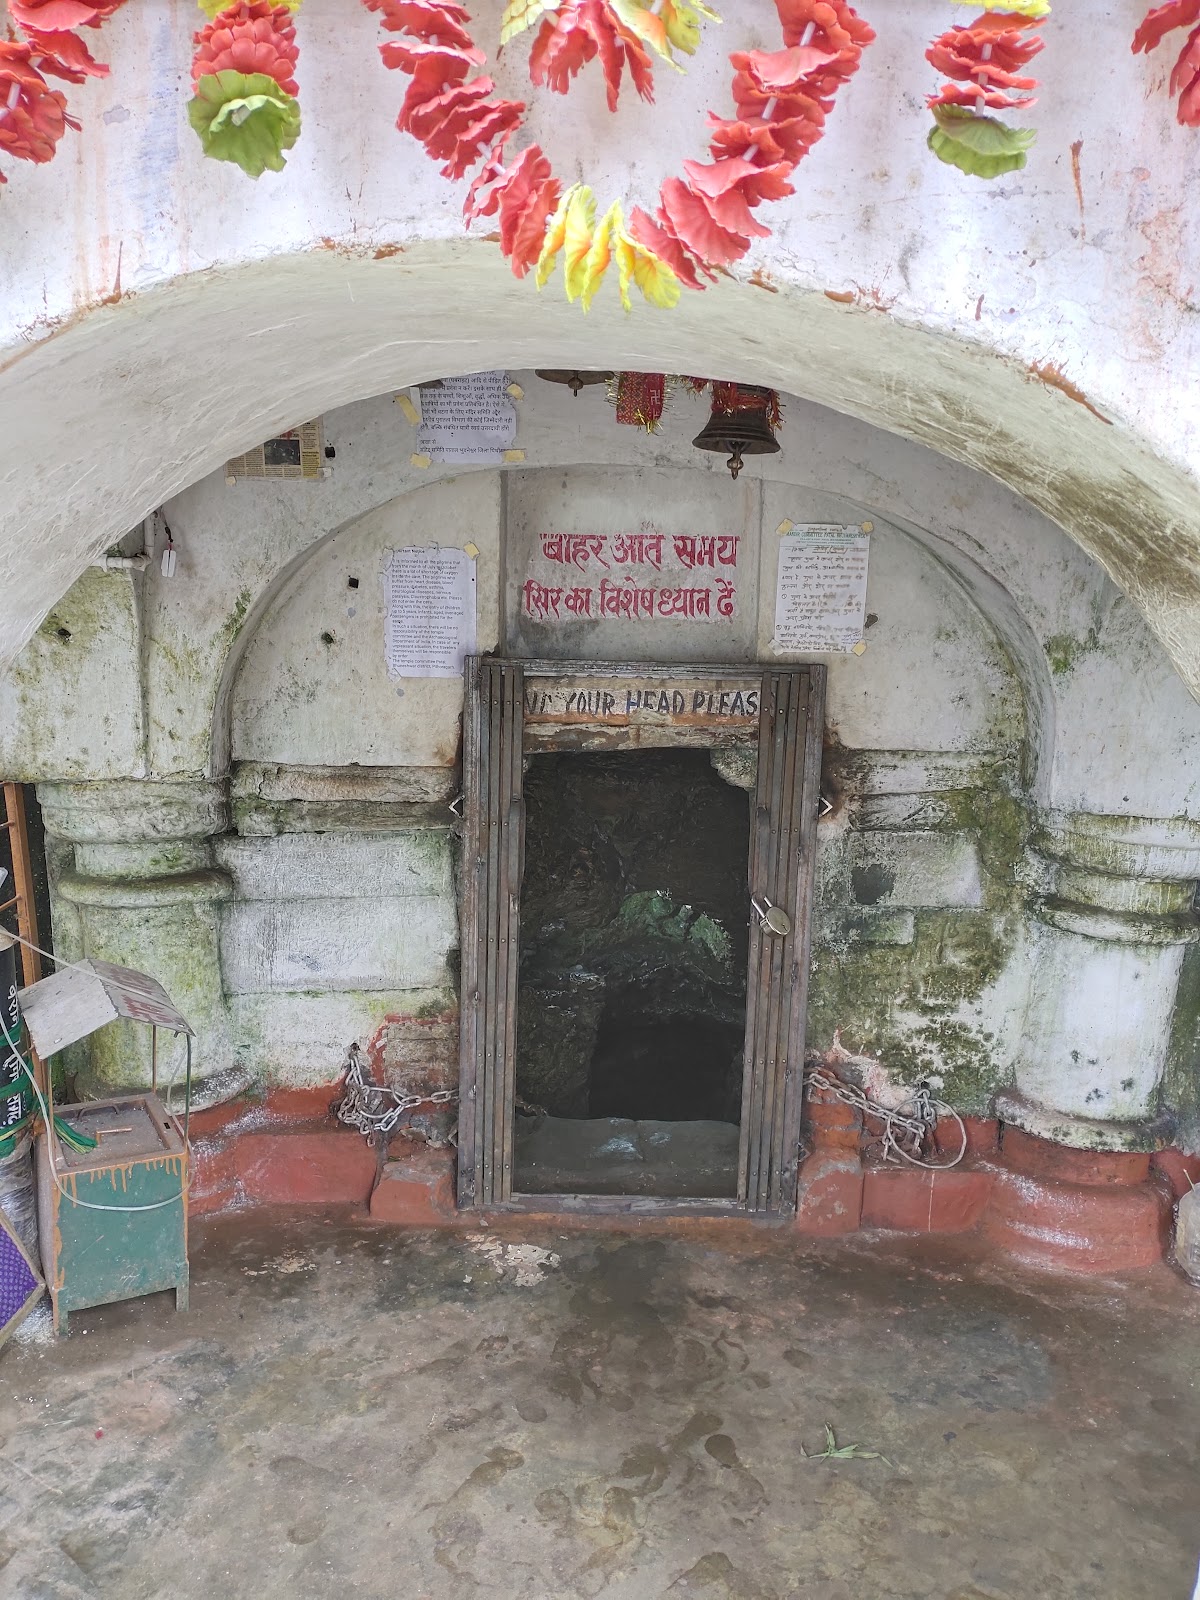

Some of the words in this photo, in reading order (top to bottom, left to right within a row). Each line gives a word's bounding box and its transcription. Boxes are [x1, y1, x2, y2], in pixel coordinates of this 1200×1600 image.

[673, 533, 740, 569] समय
[523, 579, 564, 619] सिर
[565, 587, 592, 618] का
[599, 576, 657, 620] विशेष
[658, 587, 712, 619] ध्यान
[560, 690, 615, 716] YOUR
[626, 690, 684, 715] HEAD
